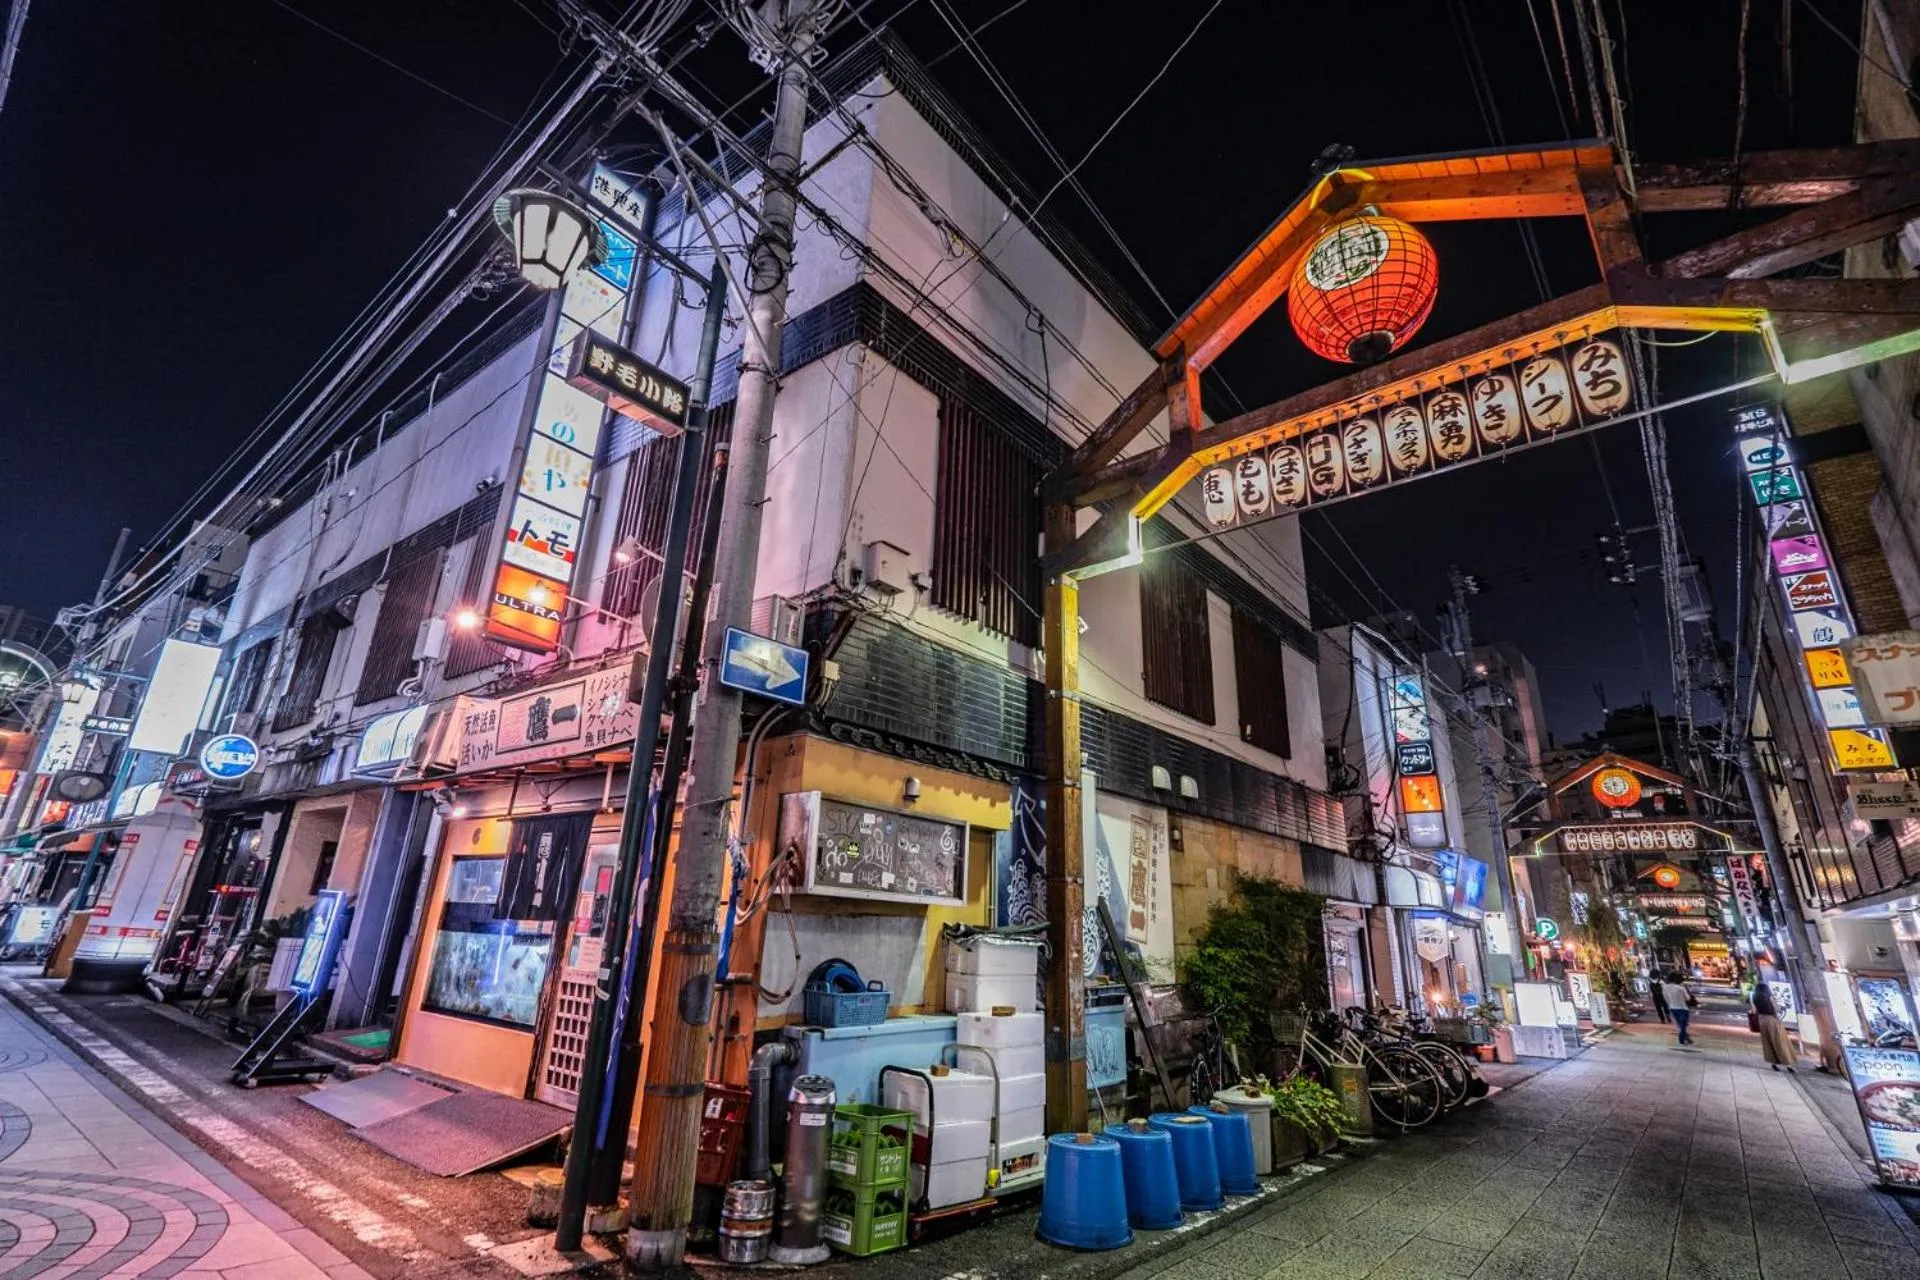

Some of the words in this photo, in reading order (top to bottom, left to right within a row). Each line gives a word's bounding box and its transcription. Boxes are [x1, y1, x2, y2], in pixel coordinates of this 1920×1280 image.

[589, 344, 684, 415] 野毛小路
[1525, 362, 1565, 417] シープ
[1578, 346, 1622, 400] みち
[1474, 376, 1506, 432] ゆき
[1270, 447, 1300, 496] つばさ
[1308, 436, 1336, 486] HUG
[1345, 420, 1374, 474] うさぎ
[1239, 458, 1266, 505] もも
[516, 519, 570, 556] トモ
[494, 593, 562, 622] ULTRA
